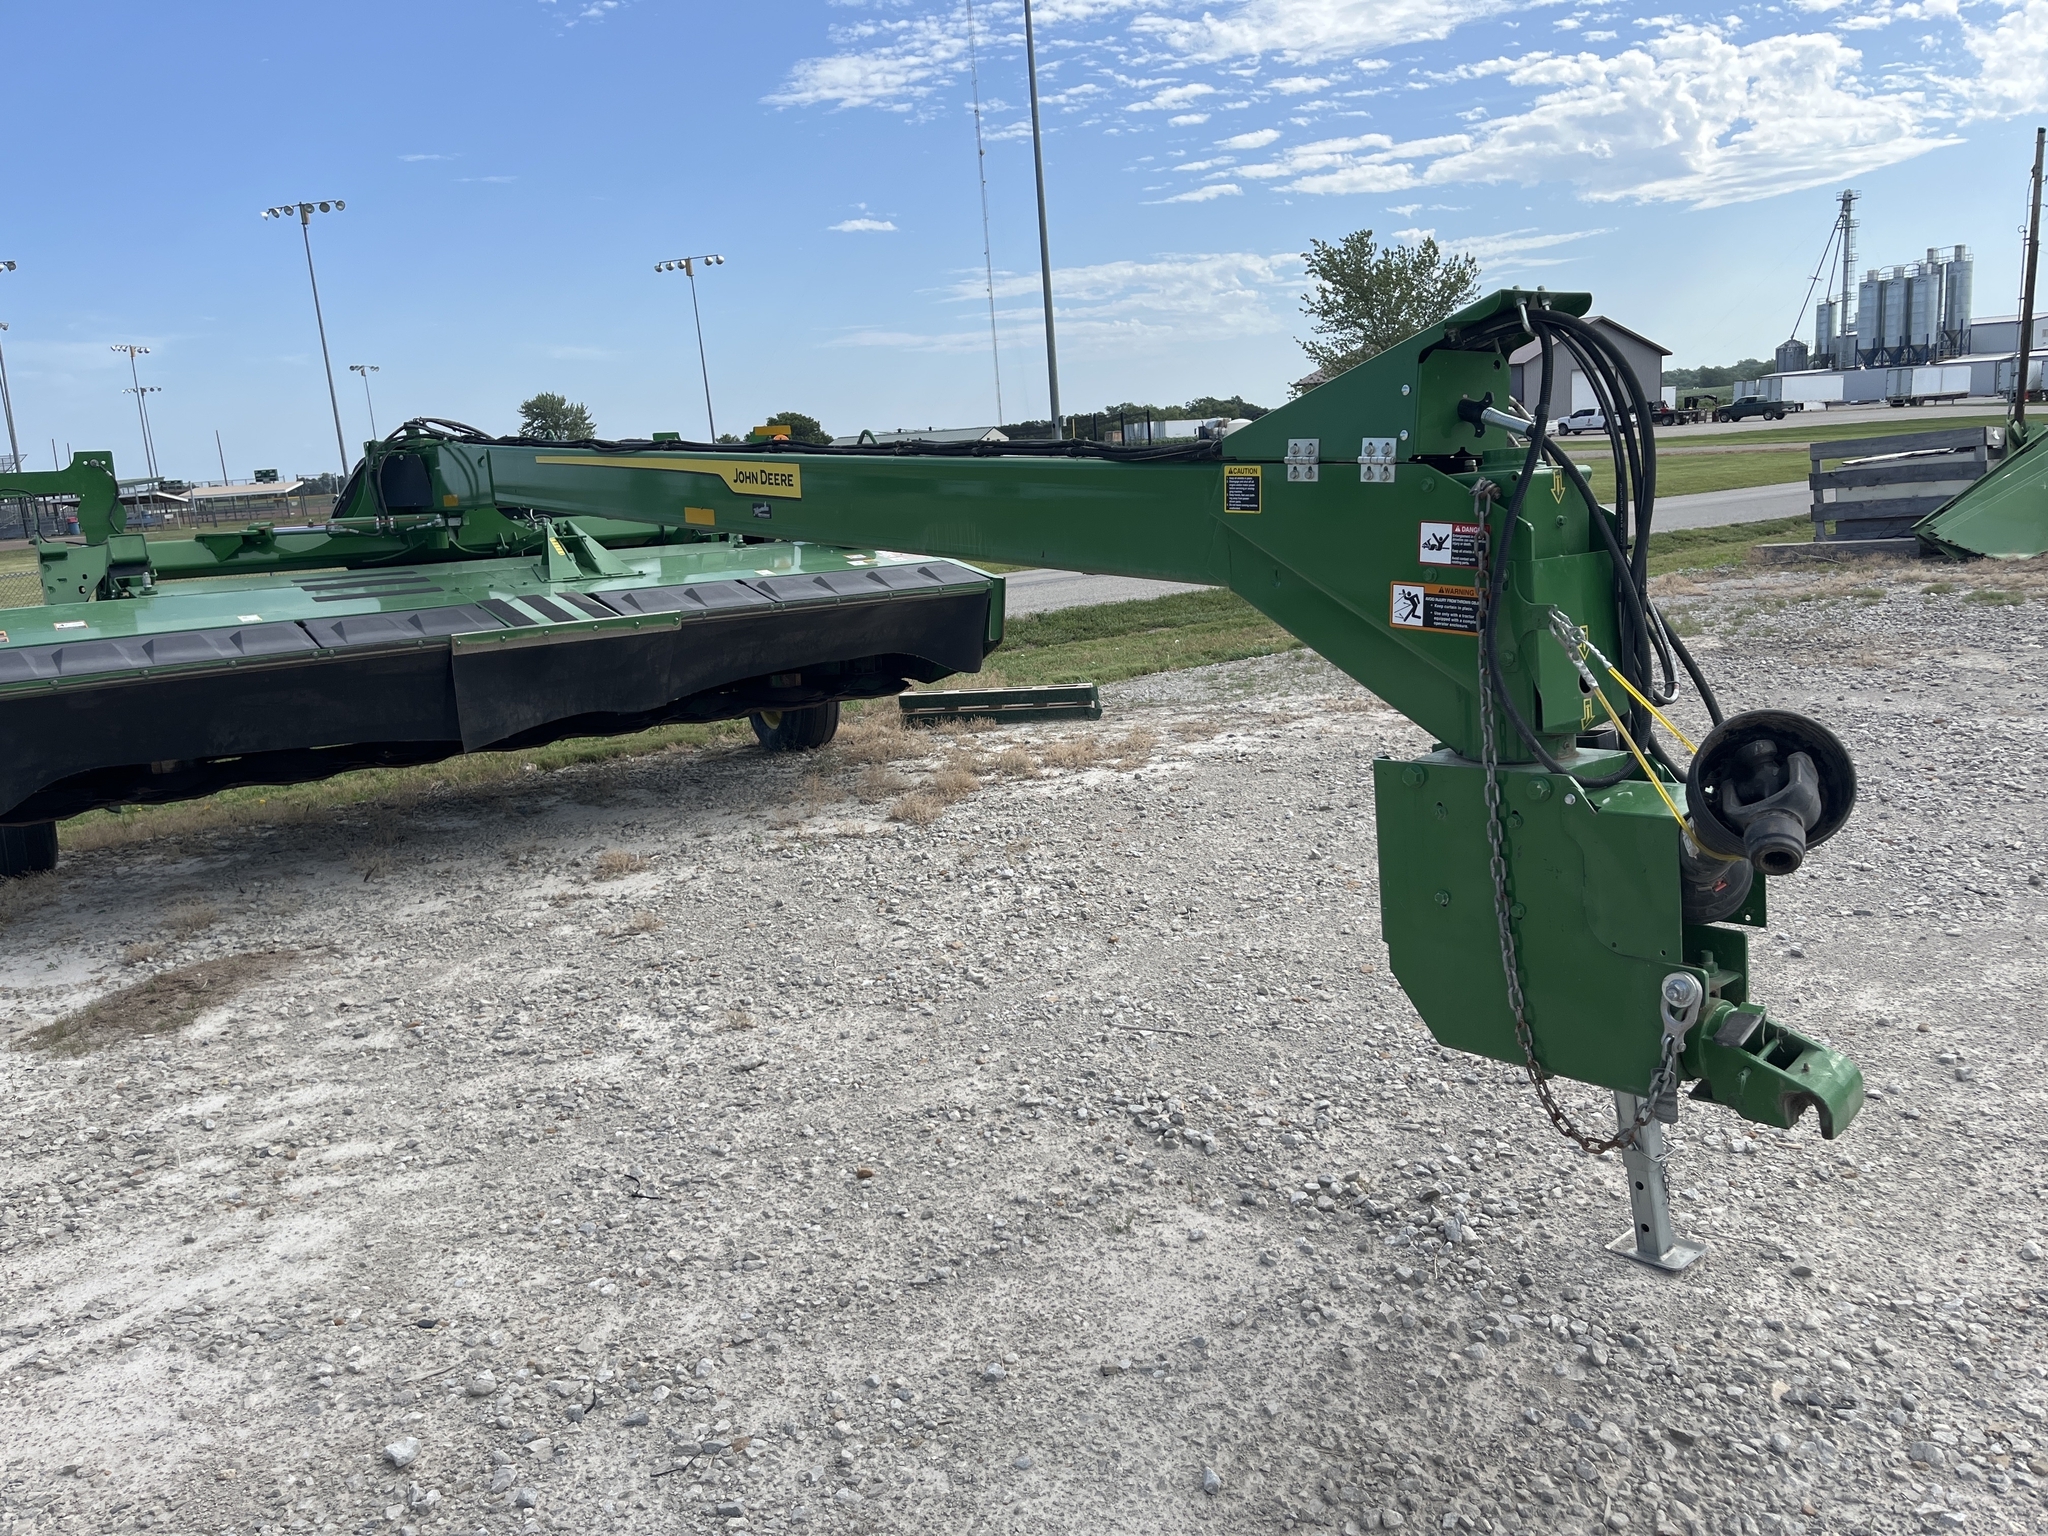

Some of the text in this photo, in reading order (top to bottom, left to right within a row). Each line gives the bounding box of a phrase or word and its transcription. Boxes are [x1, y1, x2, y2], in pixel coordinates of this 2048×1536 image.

[733, 468, 794, 487] JOHN DEERE
[1445, 588, 1474, 596] WARNING
